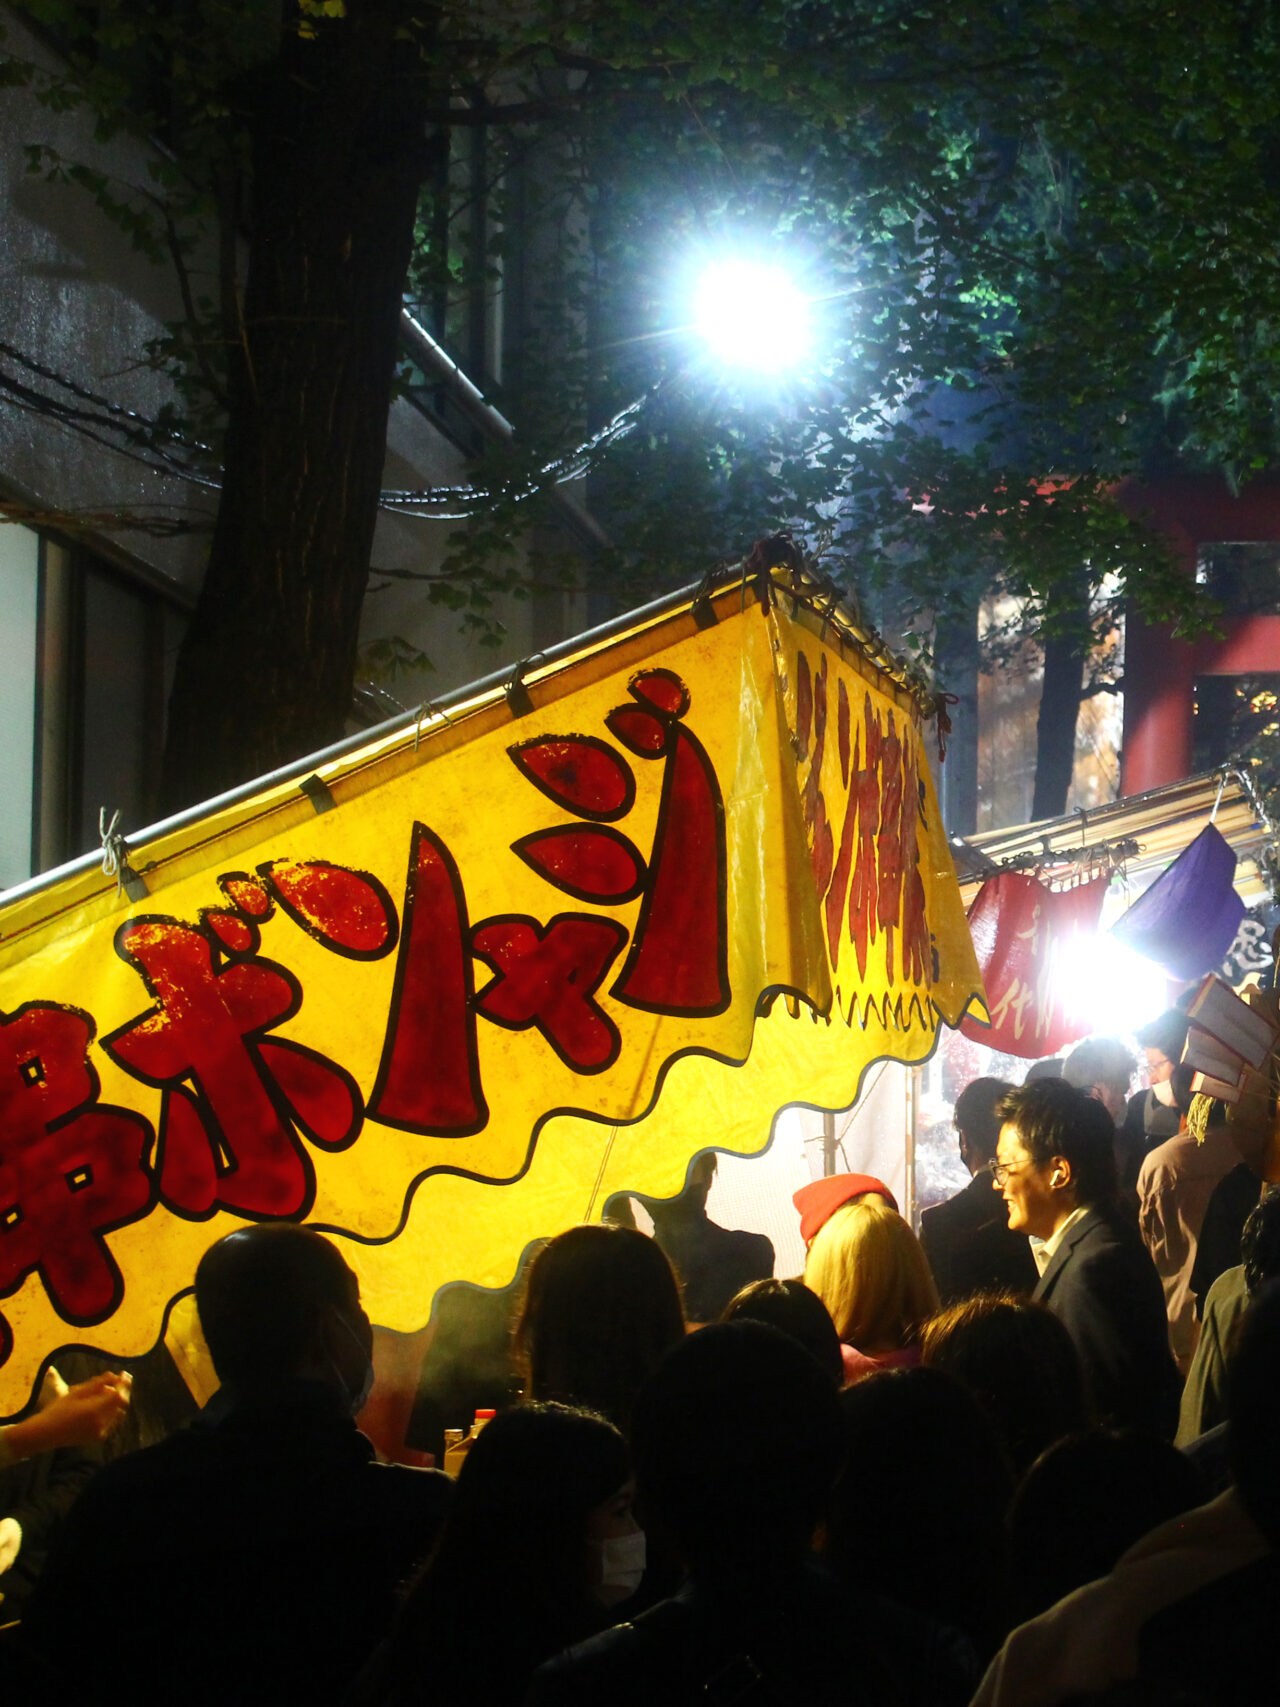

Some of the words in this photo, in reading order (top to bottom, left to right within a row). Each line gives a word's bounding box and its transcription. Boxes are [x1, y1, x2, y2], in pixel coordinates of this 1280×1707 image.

[0, 666, 732, 1369] ジャンボ串
